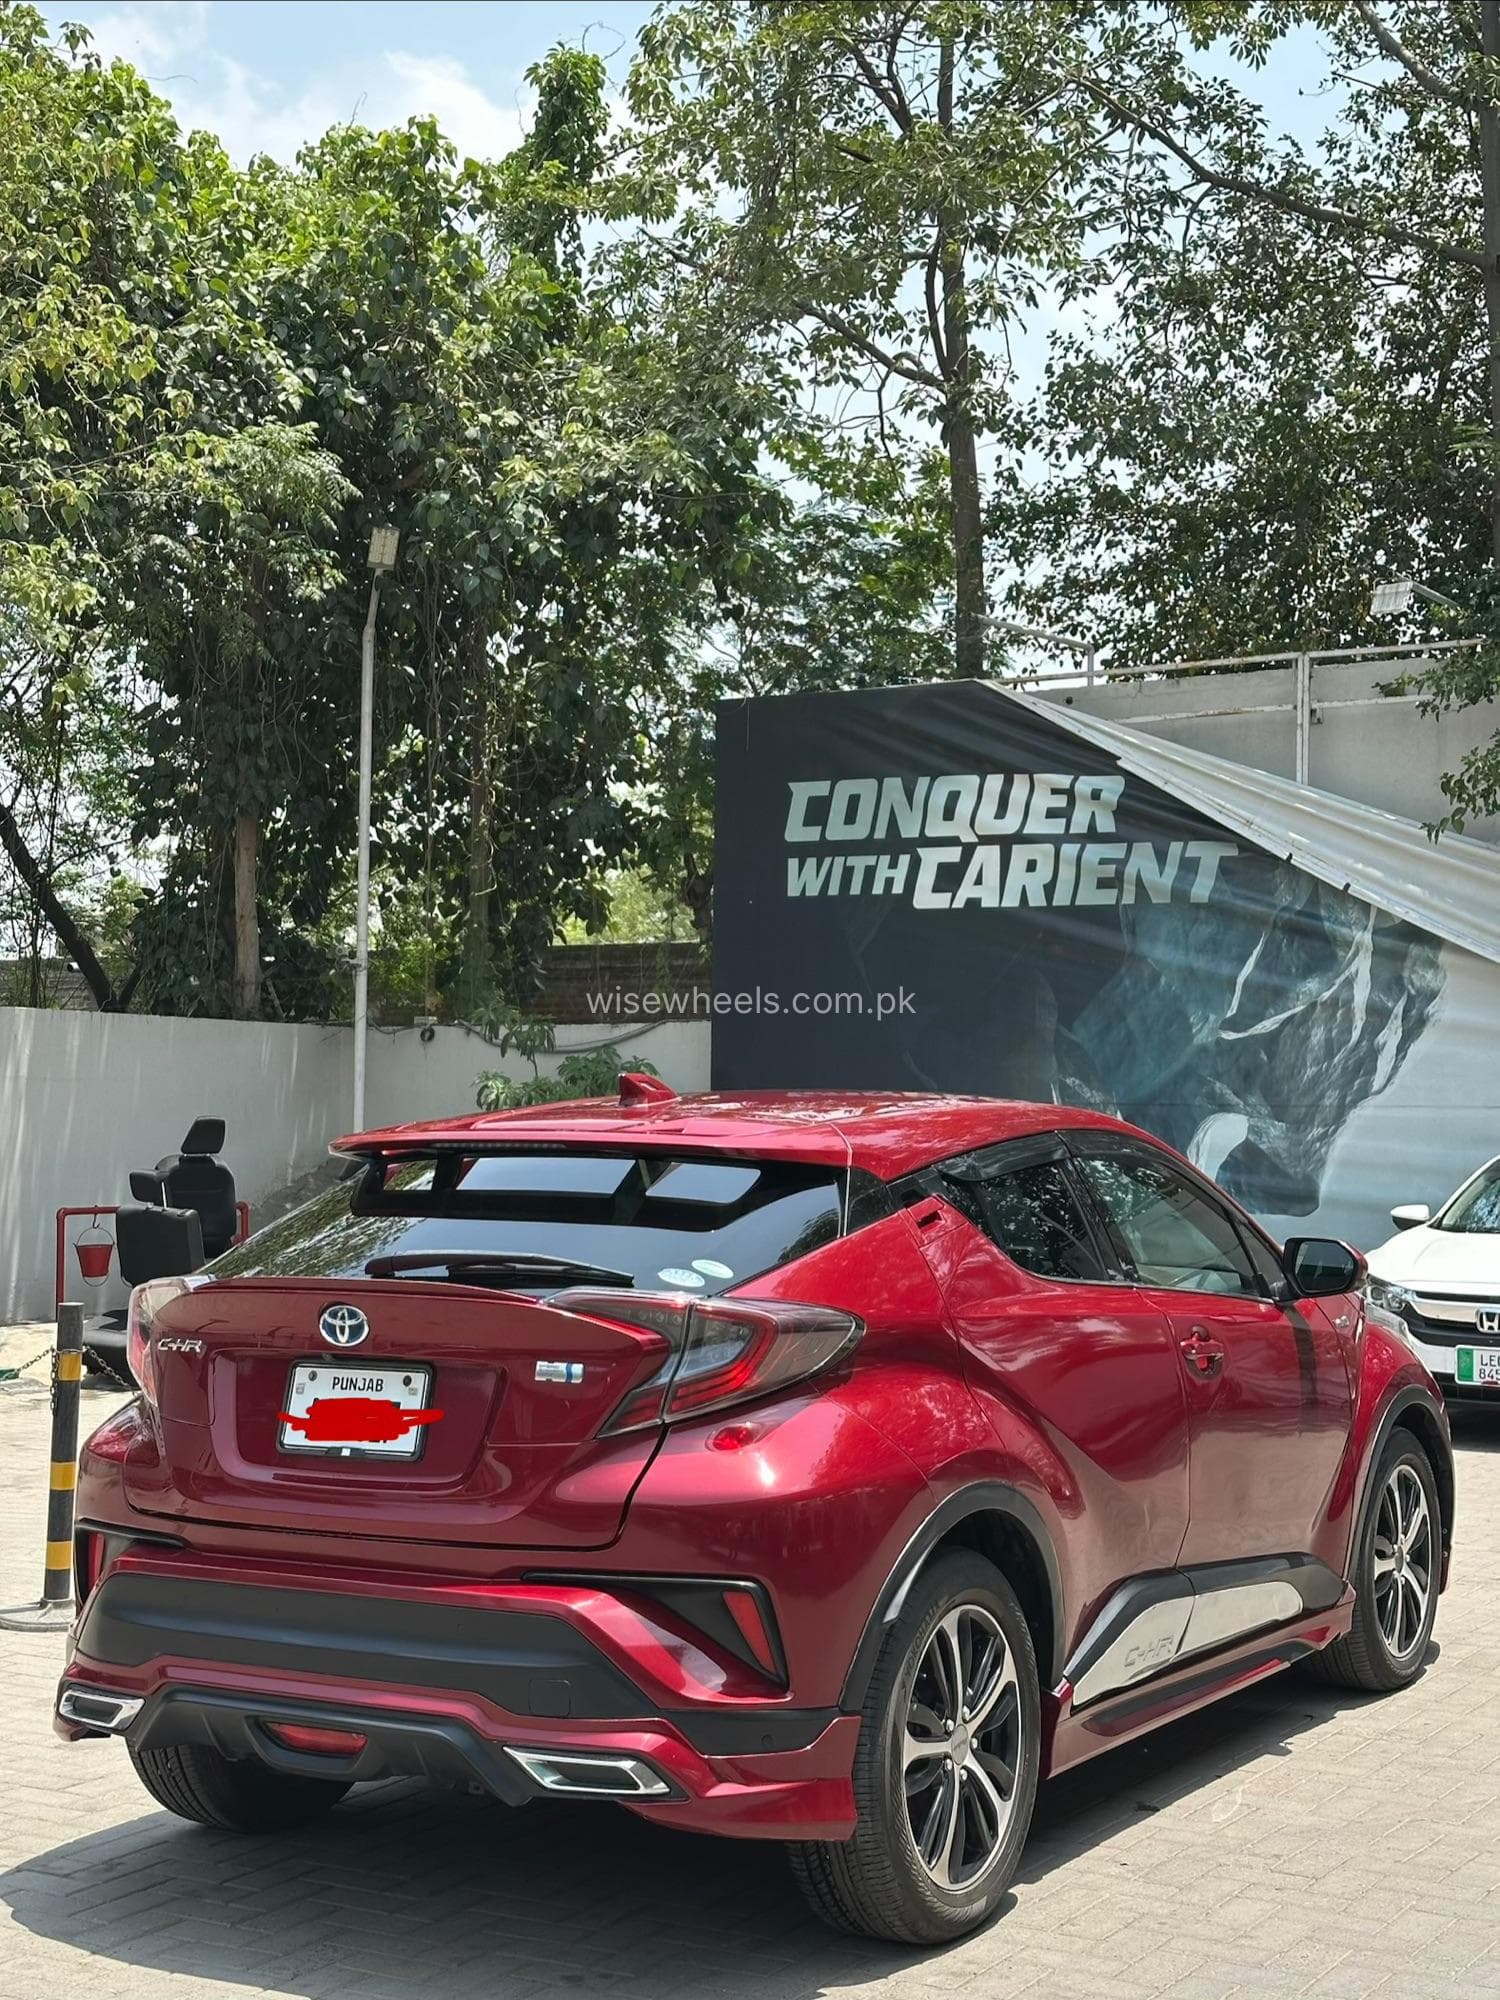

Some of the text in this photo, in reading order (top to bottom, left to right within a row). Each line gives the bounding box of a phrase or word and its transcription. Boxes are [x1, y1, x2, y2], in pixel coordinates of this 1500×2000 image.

[784, 773, 1126, 843] CONQUER
[786, 840, 1239, 910] WITH CARIENT
[332, 1376, 384, 1393] PUNJAB
